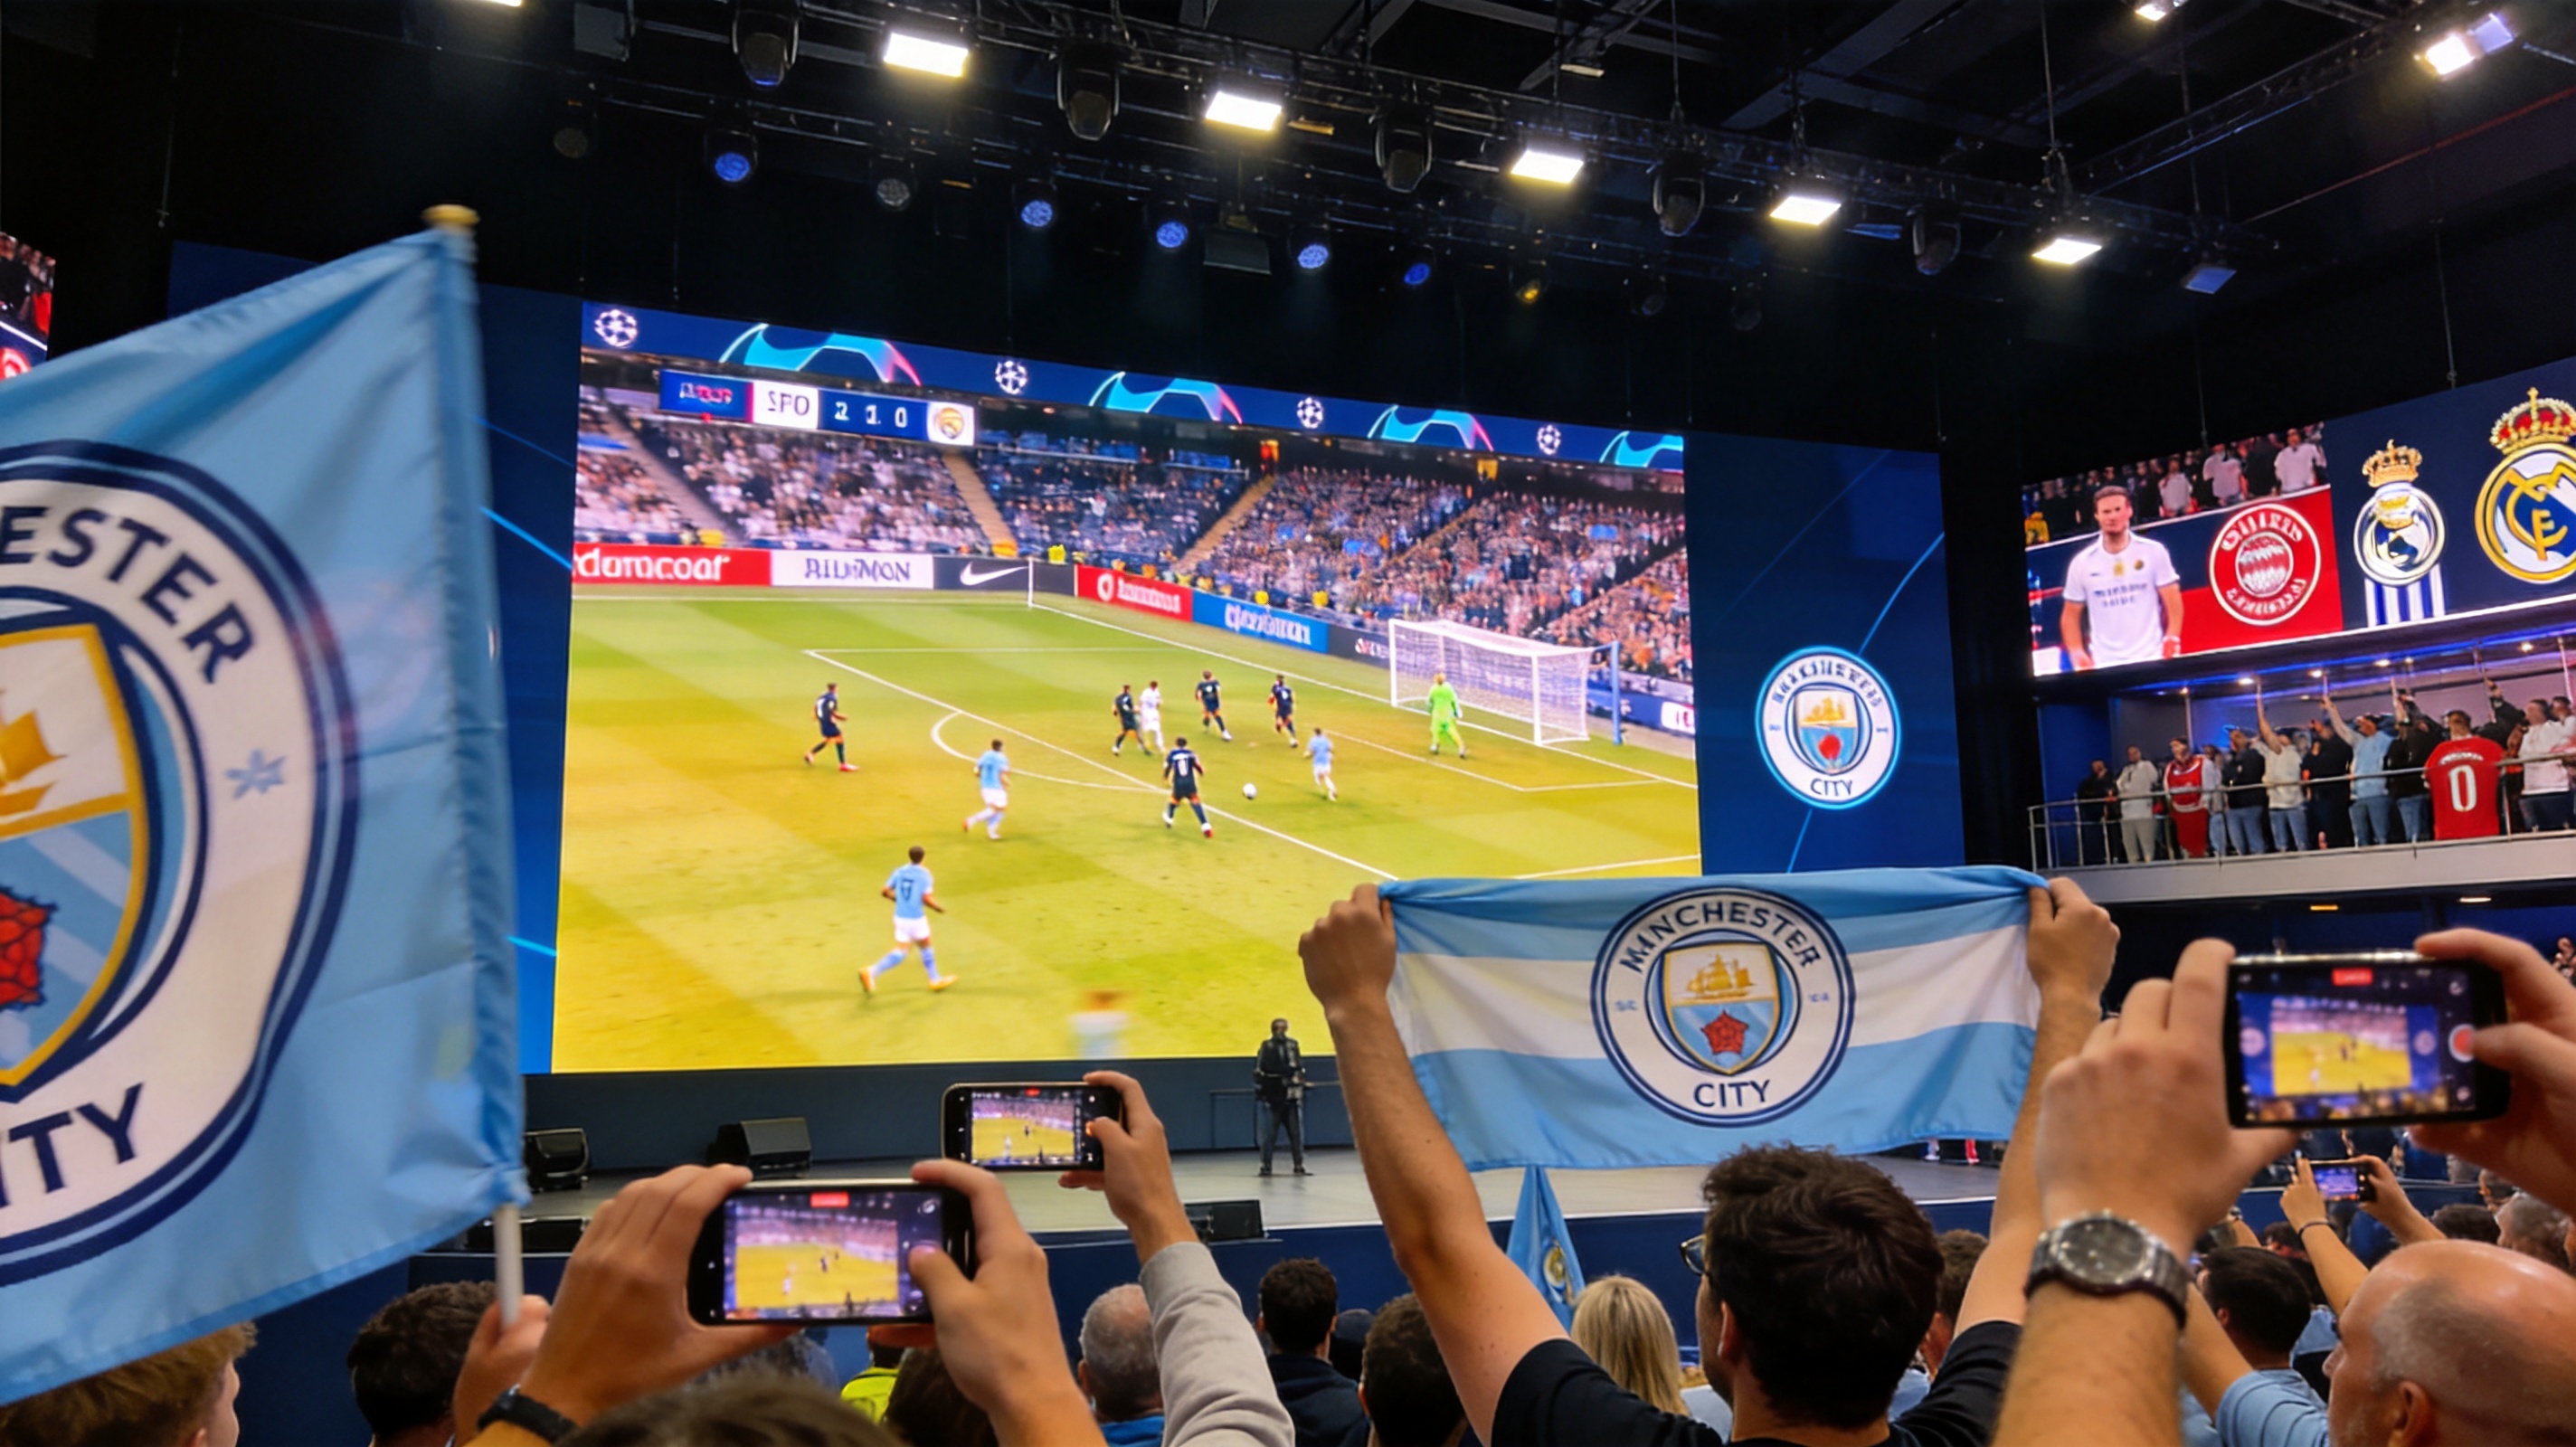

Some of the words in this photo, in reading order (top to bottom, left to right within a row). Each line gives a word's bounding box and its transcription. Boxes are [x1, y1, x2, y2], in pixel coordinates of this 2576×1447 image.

[895, 407, 908, 428] 0
[0, 506, 254, 685] ESTER
[1811, 778, 1853, 797] CITY
[2448, 764, 2477, 812] 0
[1619, 902, 1822, 974] MANCHESTER
[1693, 1079, 1771, 1108] CITY
[0, 1082, 145, 1209] TY
